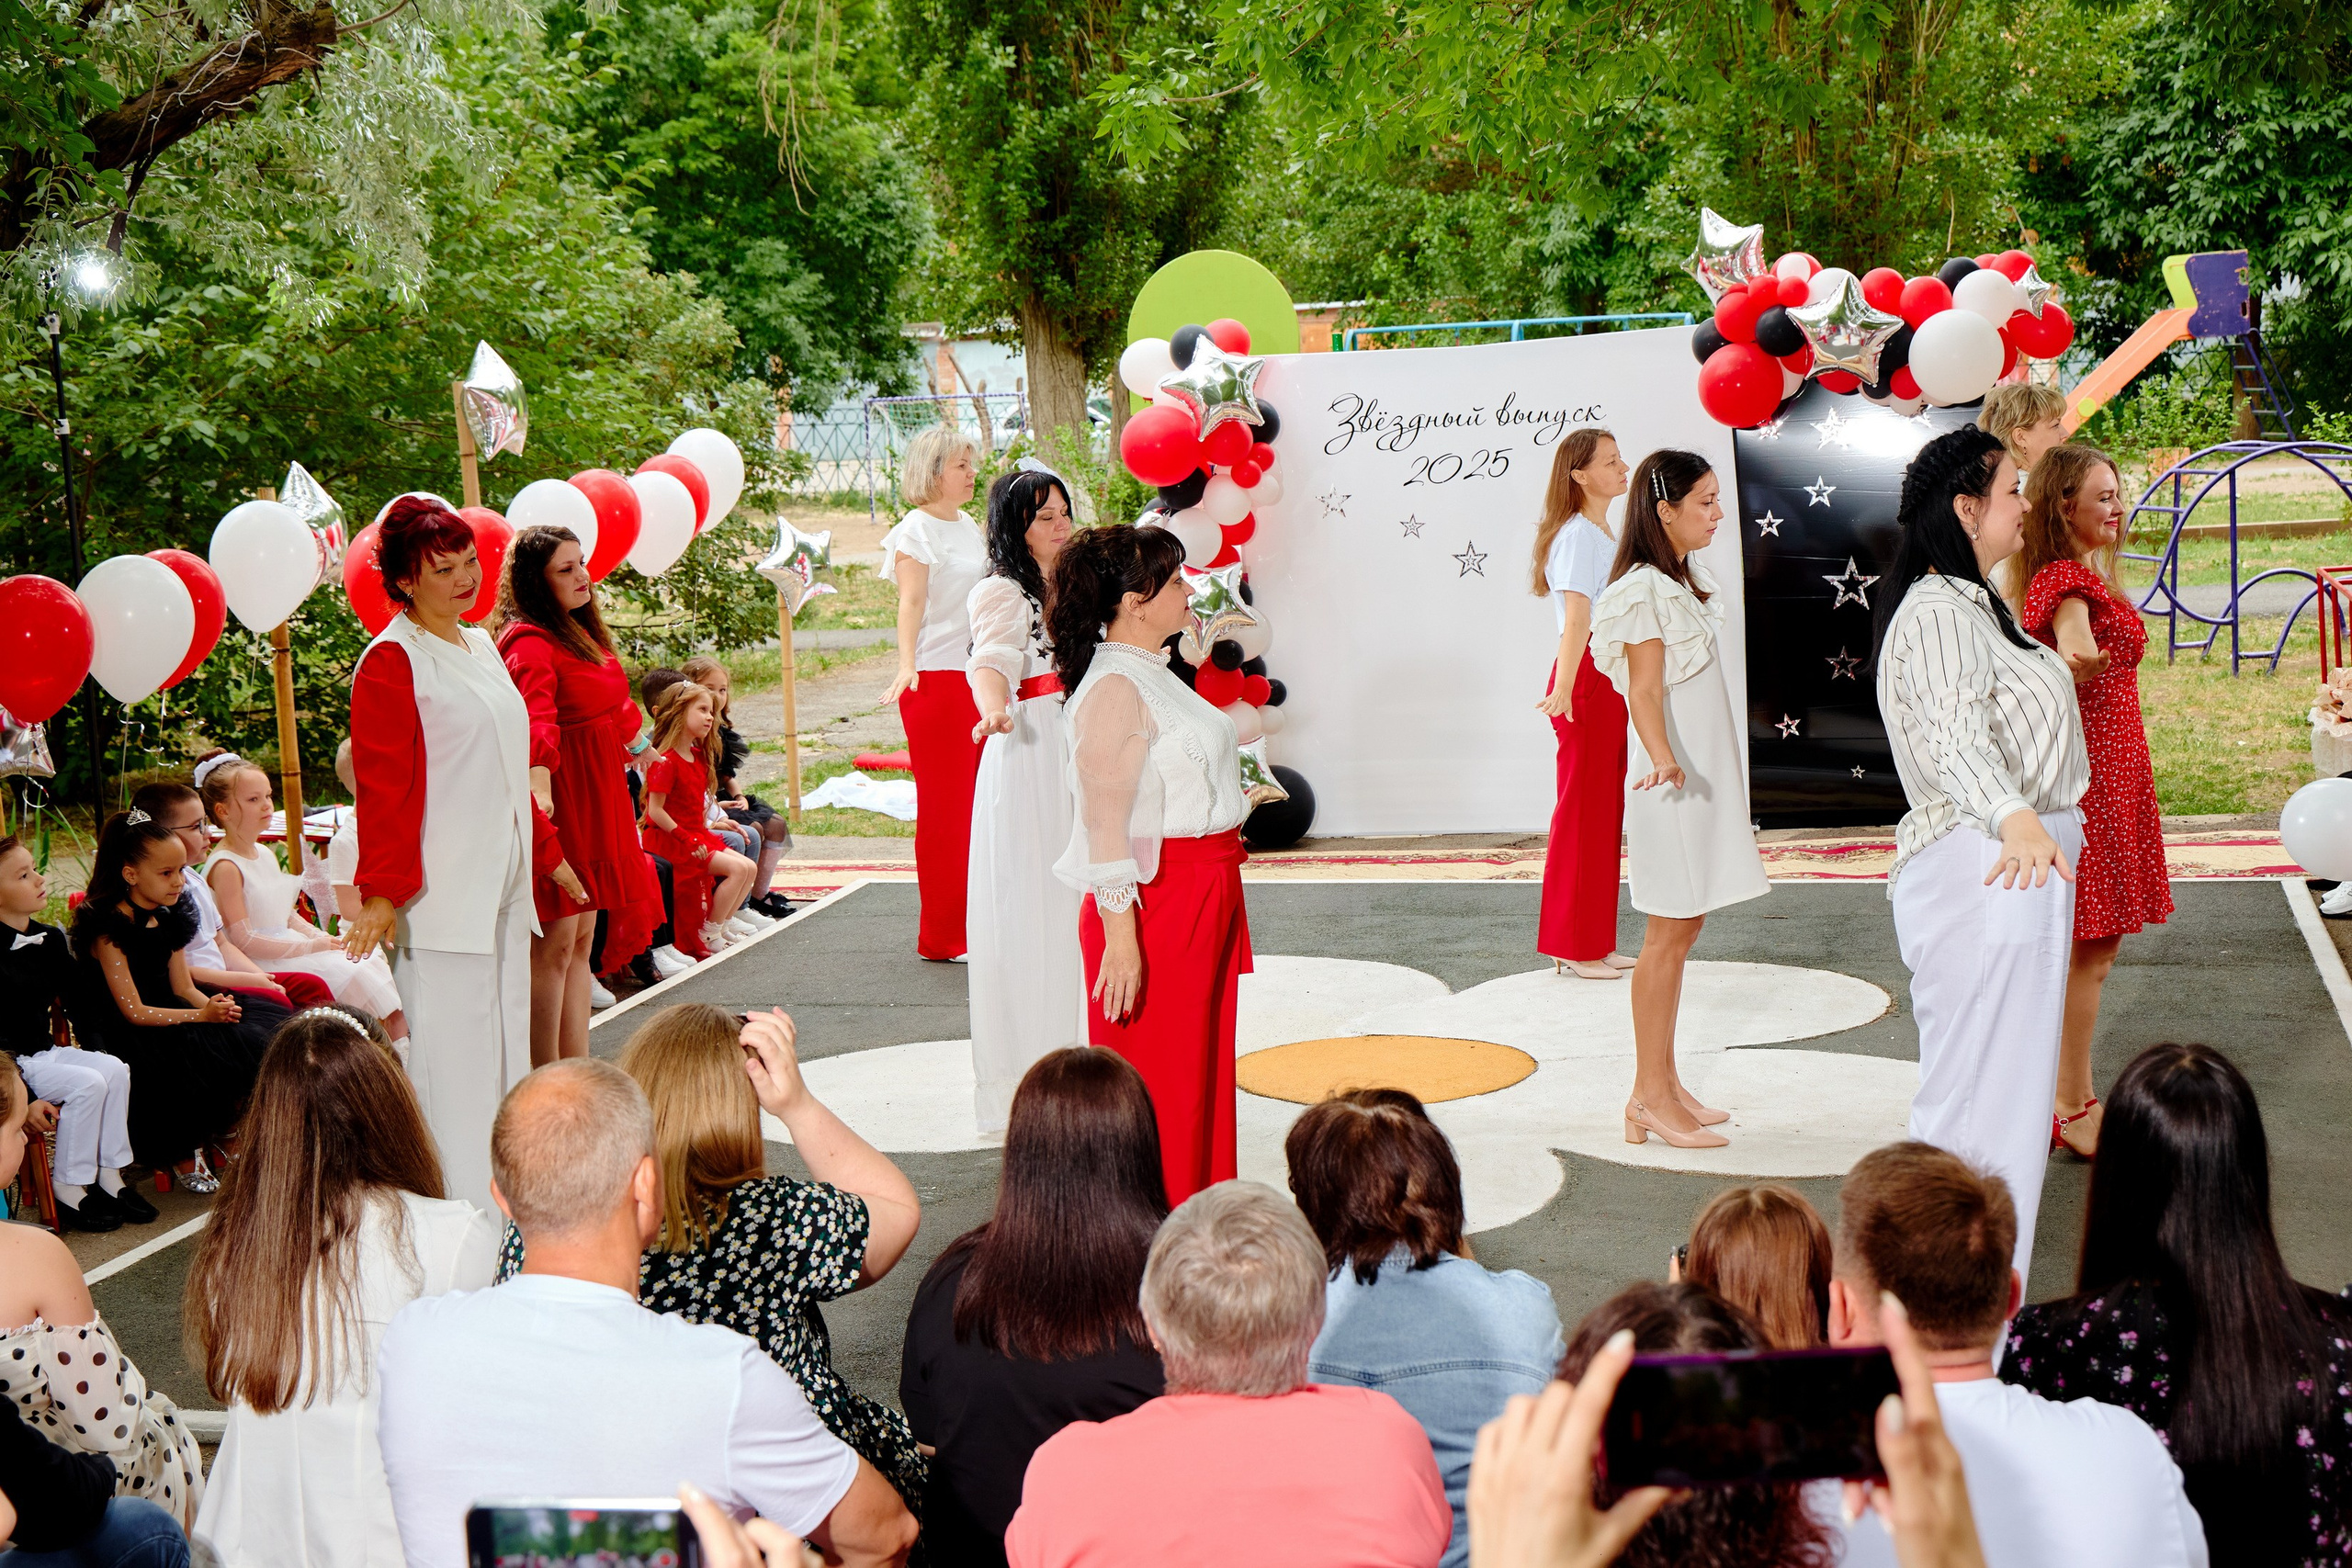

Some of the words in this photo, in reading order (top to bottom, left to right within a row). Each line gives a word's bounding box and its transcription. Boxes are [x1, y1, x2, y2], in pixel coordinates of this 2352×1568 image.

[1324, 392, 1487, 456] Звёздный
[1495, 391, 1607, 446] выпуск
[1403, 448, 1513, 487] 2025
